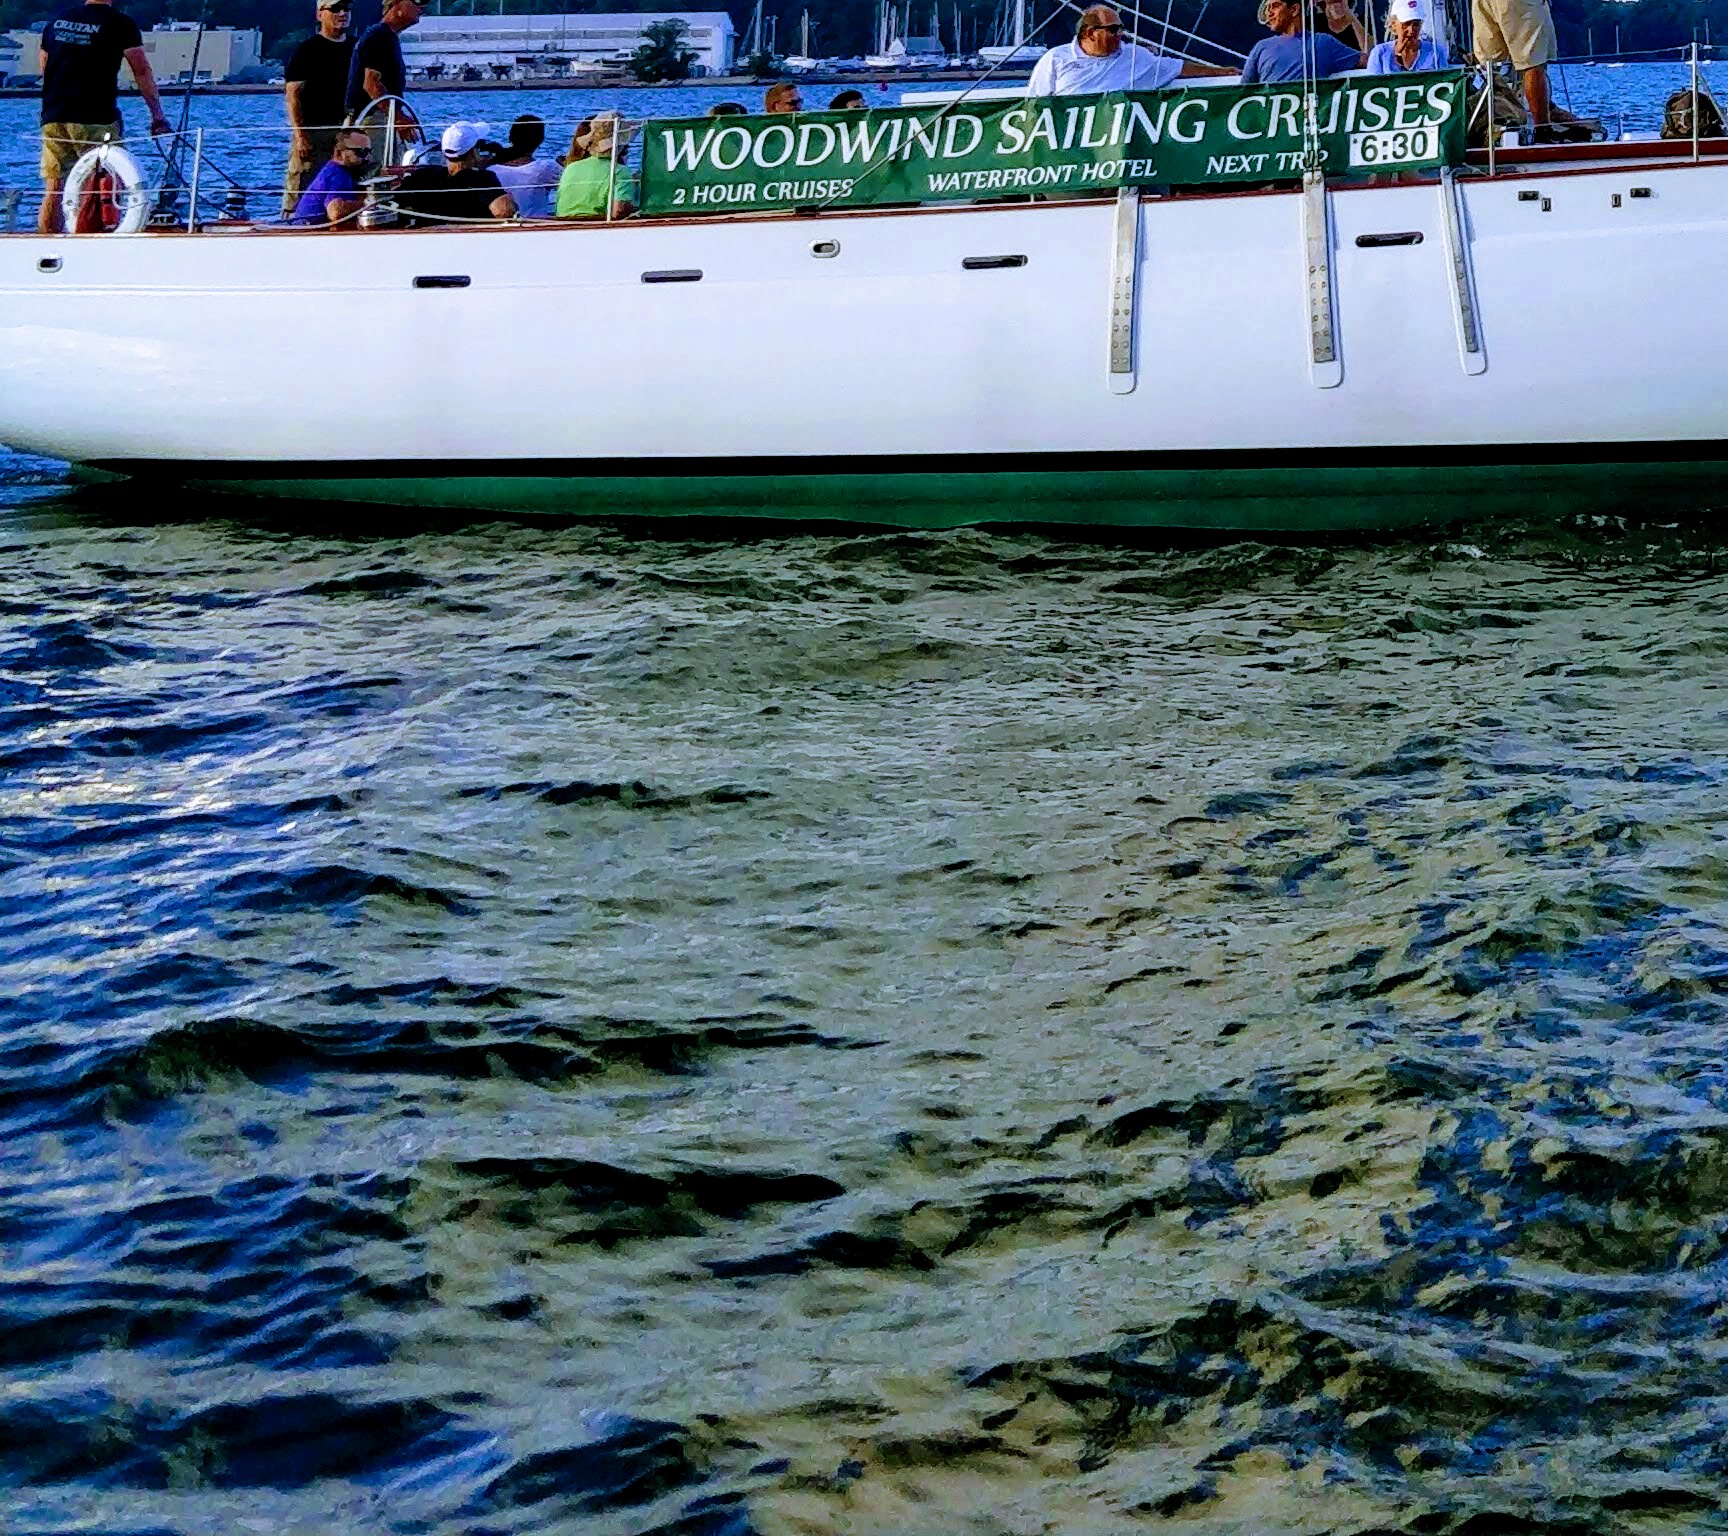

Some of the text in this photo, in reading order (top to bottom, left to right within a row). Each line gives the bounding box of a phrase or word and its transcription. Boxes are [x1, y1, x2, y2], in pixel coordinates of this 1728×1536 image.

[661, 81, 1455, 172] WOODWIND SAILING CRUISES
[1360, 130, 1429, 162] 6:30
[927, 158, 1158, 193] WATERFRONT HOTEL
[1206, 153, 1270, 176] NEXT
[671, 178, 854, 205] 2 HOUR CRUISES
